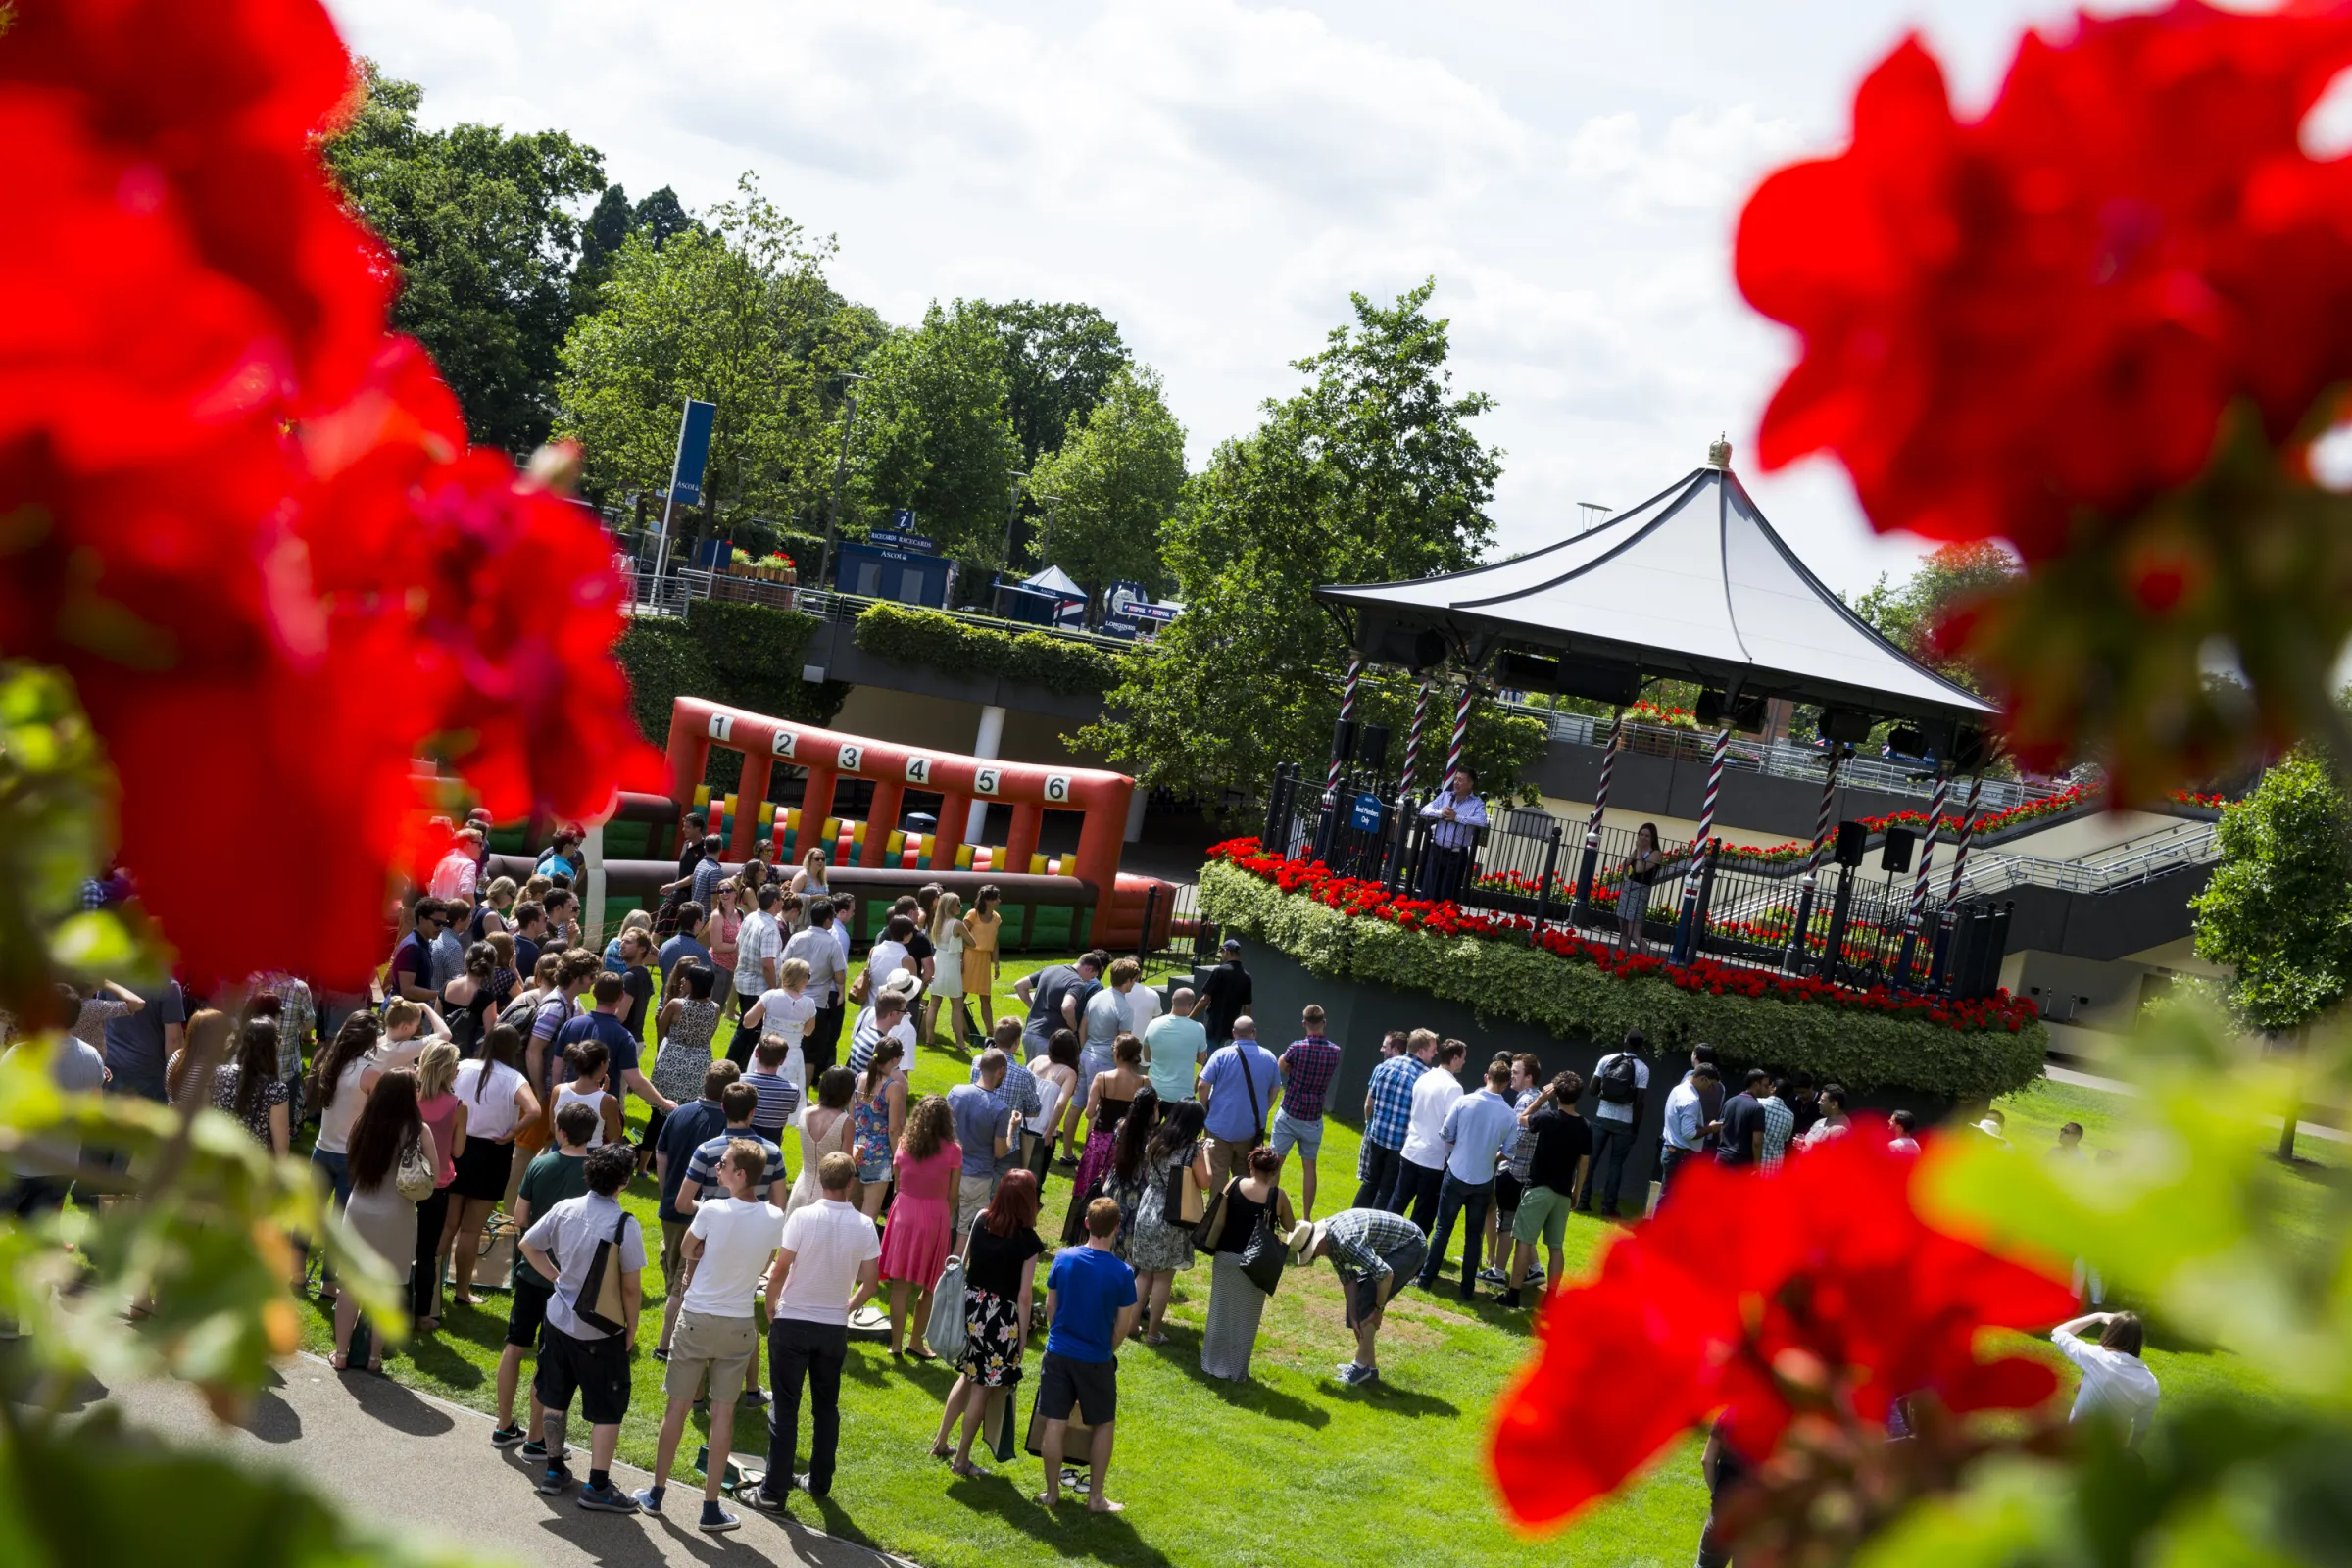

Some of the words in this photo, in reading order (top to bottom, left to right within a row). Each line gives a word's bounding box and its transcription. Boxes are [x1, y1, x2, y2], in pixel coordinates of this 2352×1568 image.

[899, 536, 932, 548] RACECARDS
[1105, 620, 1136, 631] LONGINES
[714, 716, 725, 738] 1
[776, 733, 792, 755] 2
[842, 747, 858, 768] 3
[908, 760, 924, 781] 4
[978, 769, 995, 792] 5
[1049, 777, 1065, 799] 6
